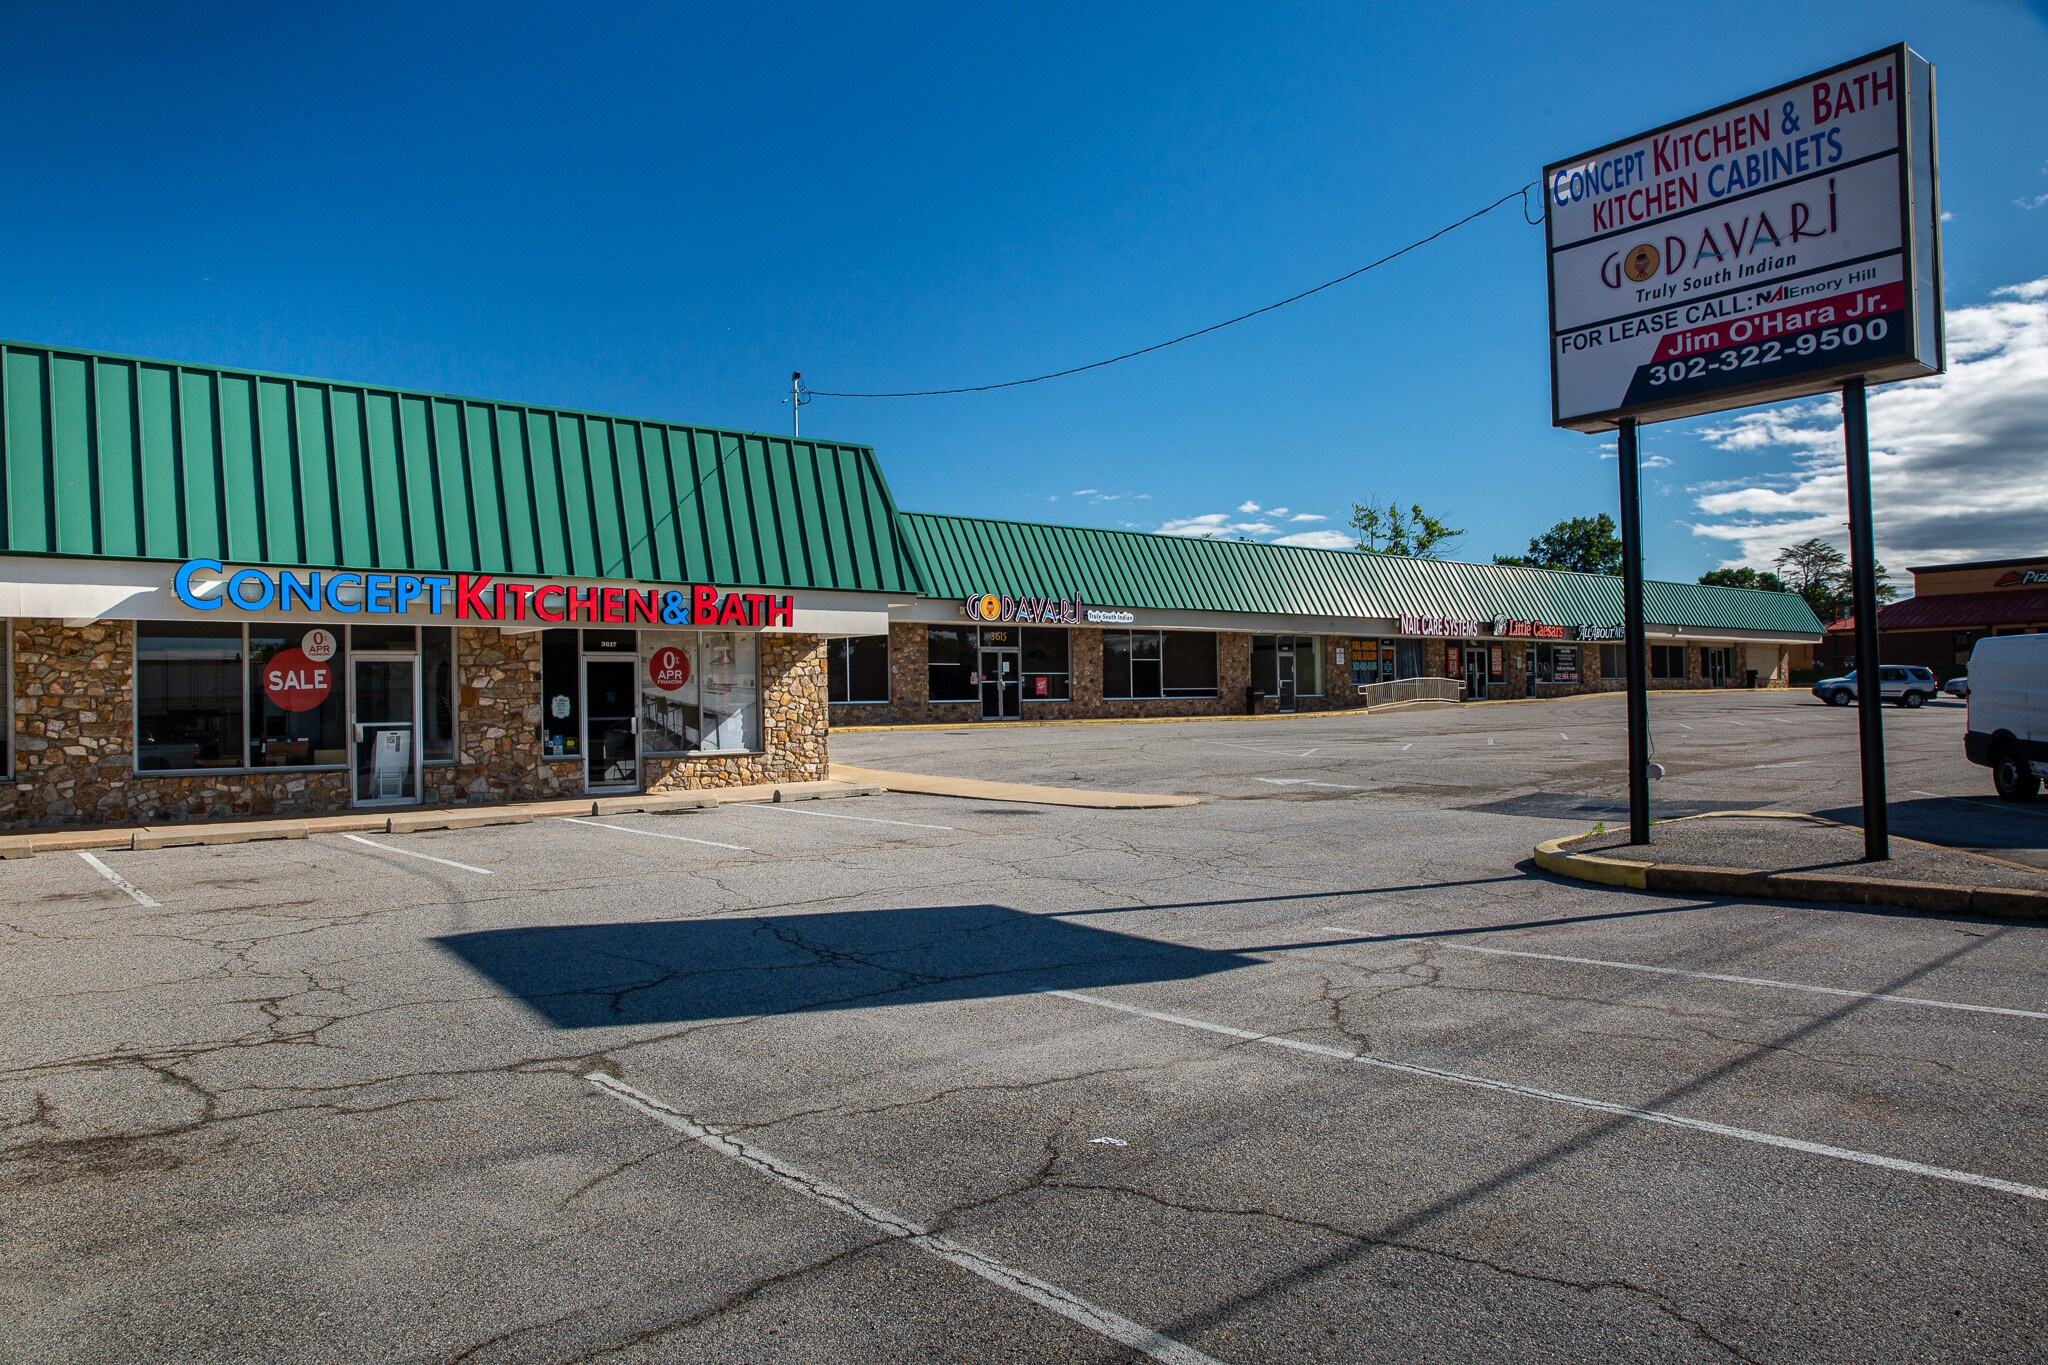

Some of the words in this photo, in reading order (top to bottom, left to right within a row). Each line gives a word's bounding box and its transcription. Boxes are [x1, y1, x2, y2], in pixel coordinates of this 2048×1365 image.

[1554, 150, 1645, 207] CONCEPT
[1653, 109, 1770, 176] KITCHEN
[1781, 101, 1800, 135] &
[1813, 66, 1893, 125] BATH
[1593, 173, 1698, 232] KITCHEN
[1708, 127, 1842, 197] CABINETS
[1636, 283, 1677, 303] Truly
[1682, 268, 1732, 292] South
[1738, 254, 1796, 278] Indian
[1561, 330, 1602, 354] FOR
[1609, 311, 1678, 343] LEASE
[1685, 296, 1752, 324] CALL:
[1789, 278, 1843, 298] Emory
[1849, 268, 1876, 284] Hill
[1668, 331, 1719, 355] Jim
[1729, 306, 1835, 342] O'Hara
[1846, 293, 1887, 317] Jr.
[1649, 318, 1888, 386] 302-322-9500
[174, 558, 450, 615] CONCEPT
[455, 574, 659, 623] KITCHEN
[662, 590, 689, 625] &
[691, 584, 794, 627] BATH
[966, 591, 1081, 625] GODAVARI
[1089, 612, 1101, 621] Truly
[1117, 613, 1133, 621] Indian
[990, 631, 1007, 642] 3615
[1401, 614, 1420, 634] NAIL
[1421, 614, 1443, 635] CARE
[1443, 615, 1478, 637] SYSTEMS
[1508, 619, 1532, 637] Little
[1533, 620, 1564, 638] Caesars
[309, 645, 330, 653] APR
[663, 651, 680, 669] 0%
[269, 669, 328, 691] SALE
[657, 670, 683, 680] APR
